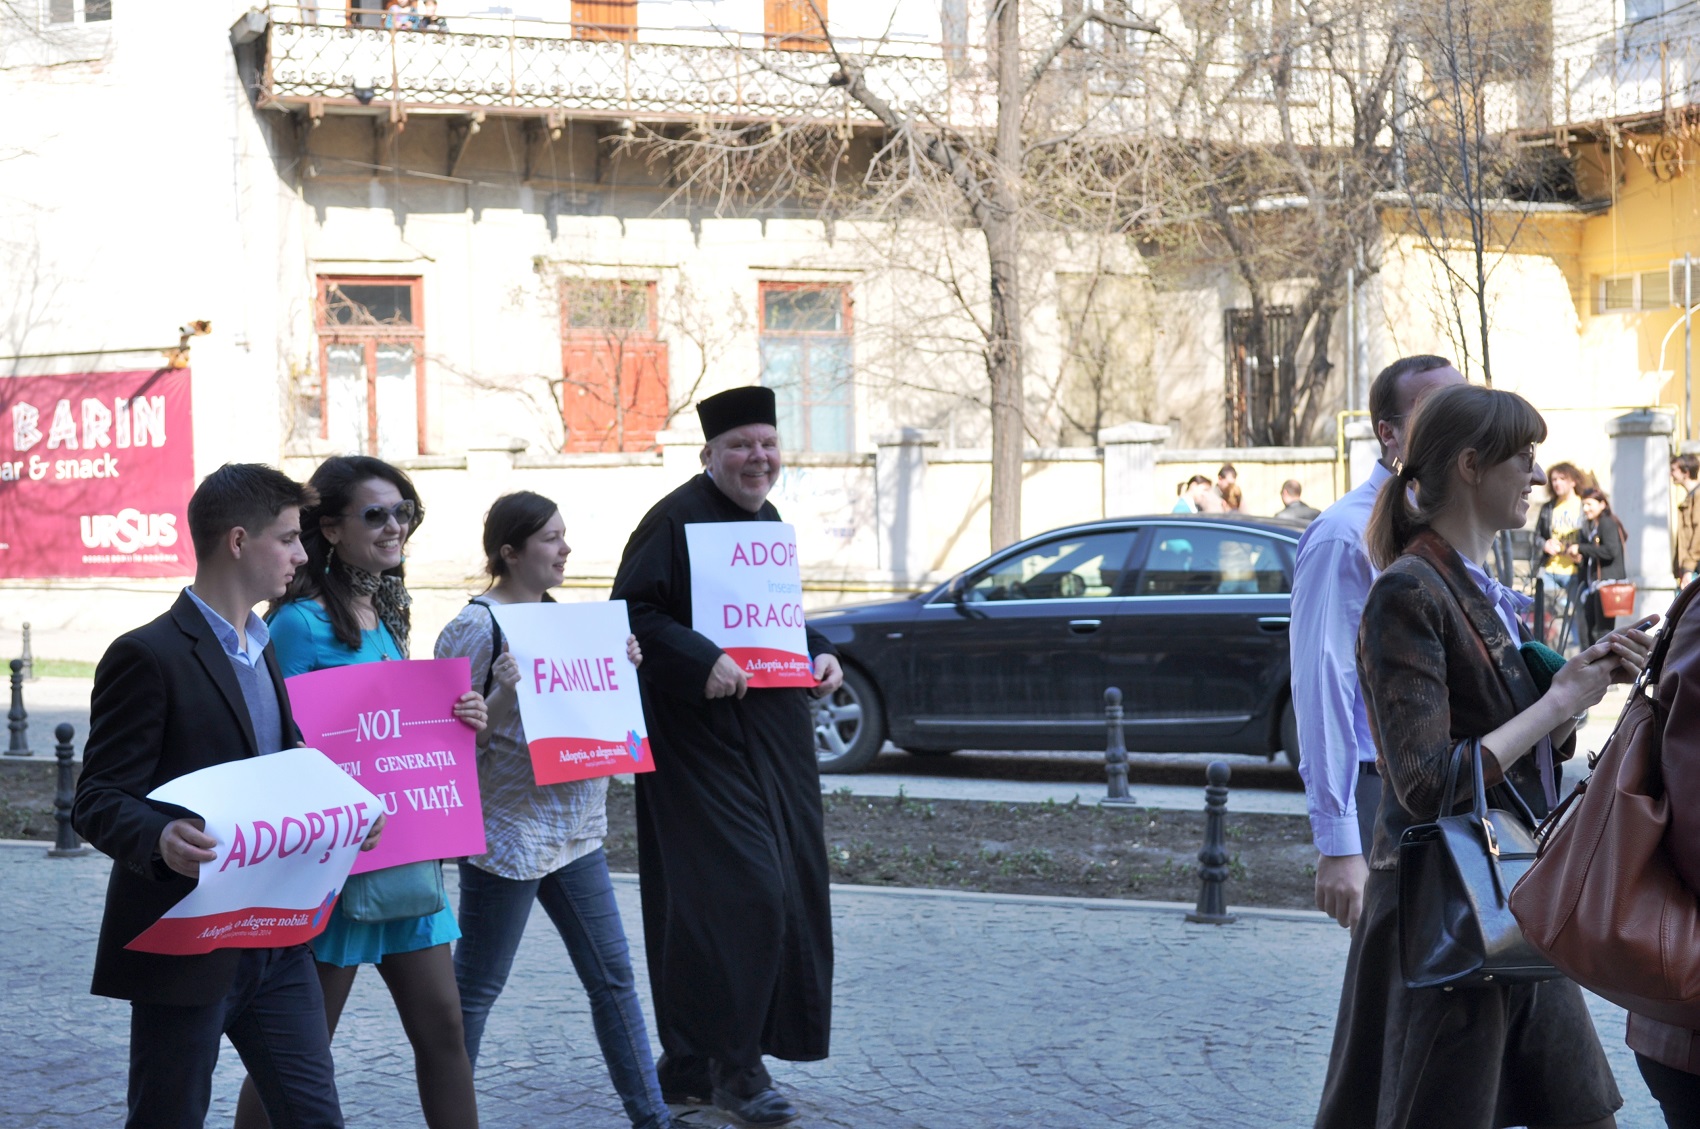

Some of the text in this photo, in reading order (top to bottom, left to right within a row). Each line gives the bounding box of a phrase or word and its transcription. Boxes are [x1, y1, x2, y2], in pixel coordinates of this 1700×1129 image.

[12, 395, 166, 452] BARIN
[0, 452, 119, 481] ar & snack
[80, 507, 178, 553] URSUS
[723, 602, 806, 629] DRAGO
[534, 657, 619, 694] FAMILIE
[355, 708, 402, 742] NOI
[374, 751, 456, 772] GENERAȚIA
[403, 779, 463, 816] VIAȚĂ
[218, 802, 370, 873] ADOPȚIE
[241, 914, 277, 930] alegere
